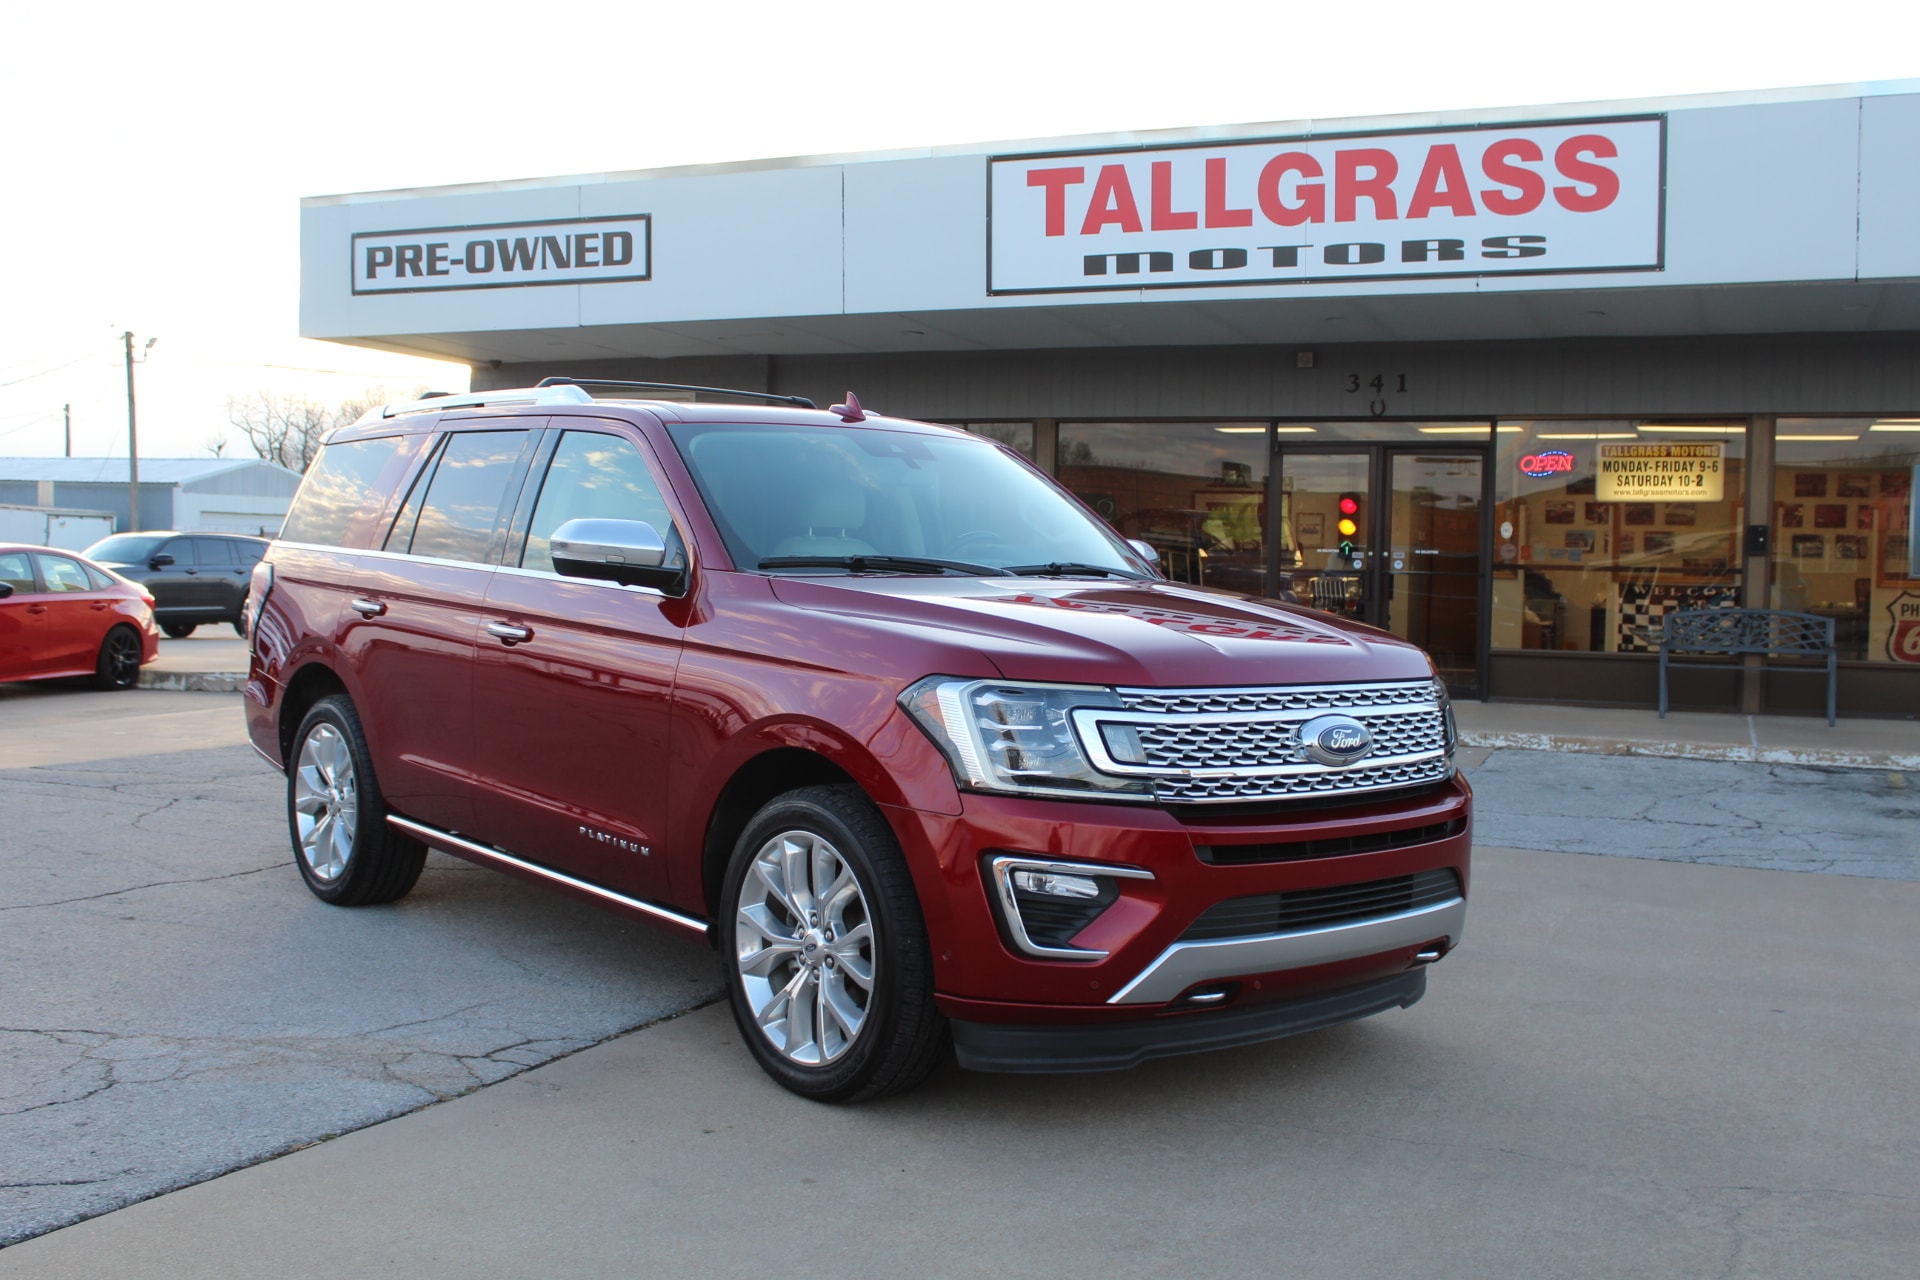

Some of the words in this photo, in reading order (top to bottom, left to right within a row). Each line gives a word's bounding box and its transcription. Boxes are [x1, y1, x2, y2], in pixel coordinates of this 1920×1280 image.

[1026, 133, 1621, 238] TALLGRASS
[365, 230, 634, 280] PRE-OWNED
[1345, 372, 1409, 394] 341
[1604, 446, 1667, 457] TALLGRASS
[1671, 446, 1718, 457] MOTORS
[1520, 455, 1574, 471] OPEN
[1699, 460, 1719, 473] 9-6
[1616, 474, 1674, 487] SATURDAY
[1678, 473, 1704, 487] 10-2
[1331, 729, 1361, 748] Ford
[579, 826, 649, 856] PLATINUM
